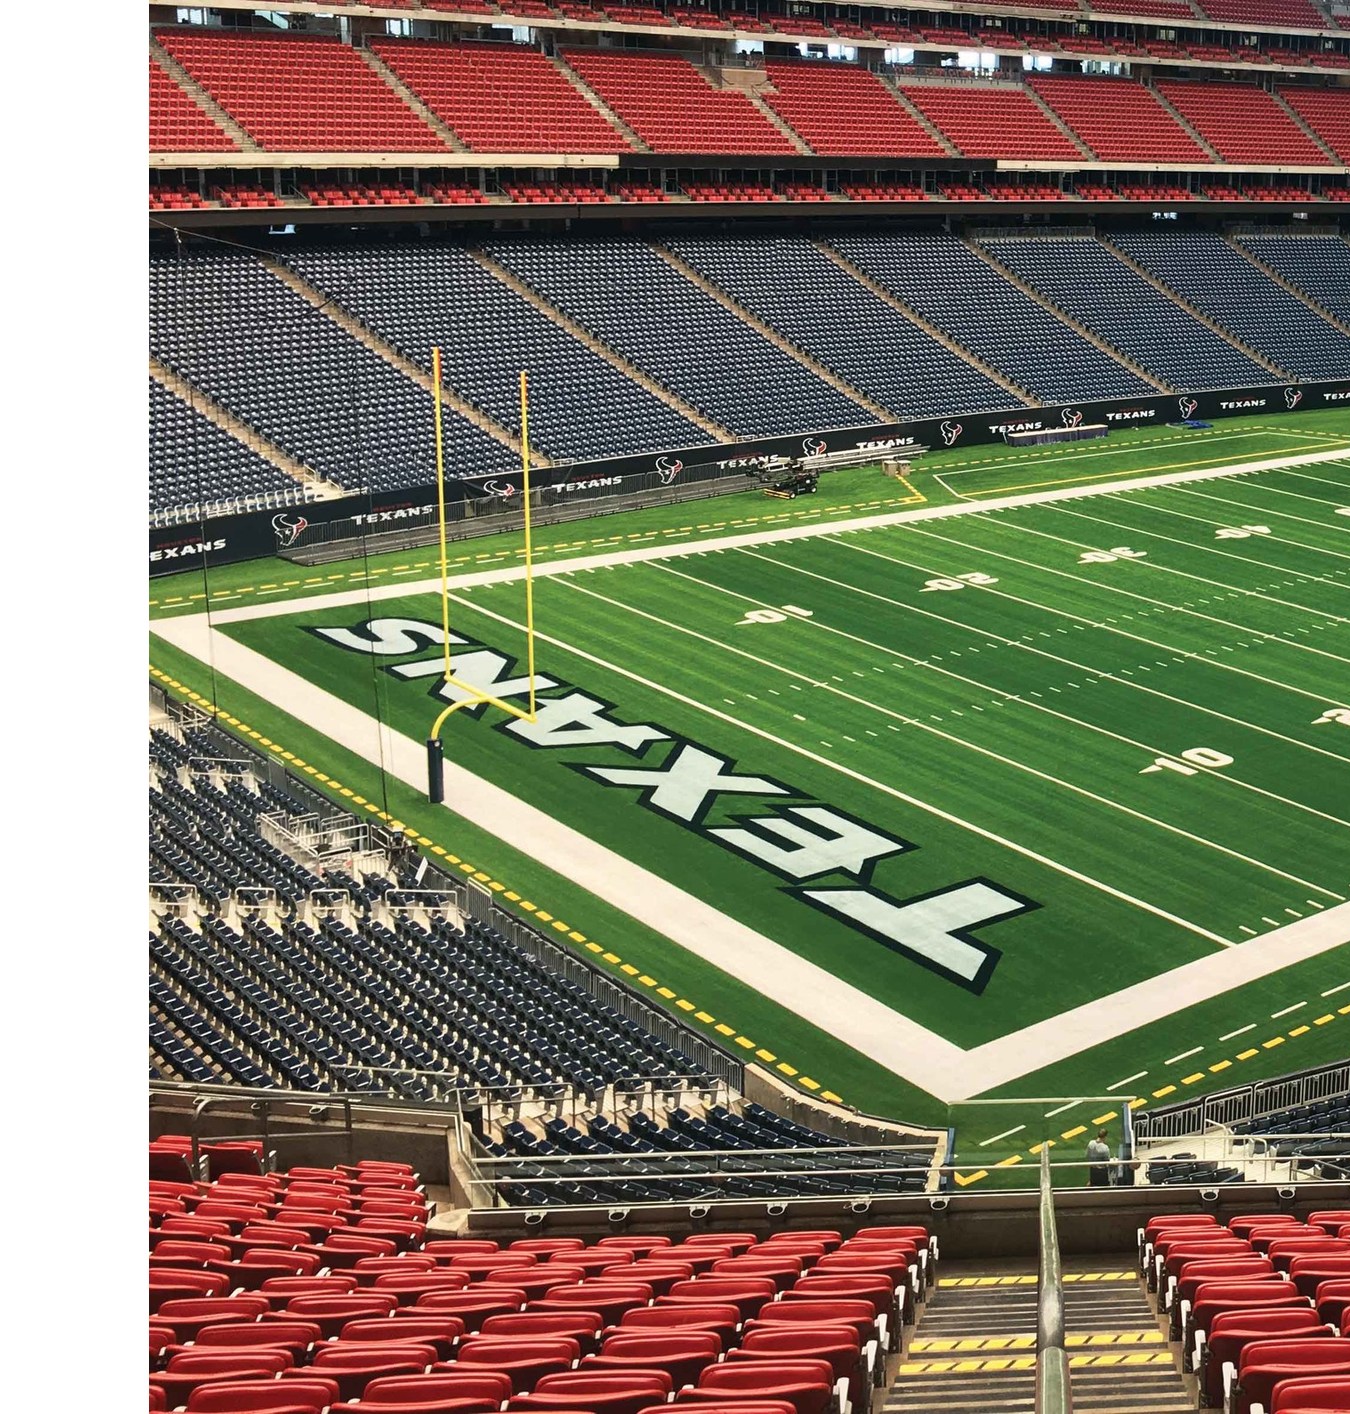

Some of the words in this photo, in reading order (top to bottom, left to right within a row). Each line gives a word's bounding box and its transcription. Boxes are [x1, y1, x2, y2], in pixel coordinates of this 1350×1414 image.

[1220, 399, 1267, 409] TEXANS
[1105, 409, 1155, 421] TEXANS
[988, 421, 1042, 434] TEXANS
[856, 436, 914, 450] TEXANS
[716, 454, 779, 470] TEXANS
[551, 475, 623, 494] TEXANS
[350, 504, 433, 526] TEXANS
[149, 538, 227, 562] EXANS
[1080, 546, 1148, 563] 30
[924, 571, 999, 591] 20
[744, 604, 814, 624] 10
[1153, 747, 1235, 777] 10
[306, 614, 1042, 994] TEXANS
